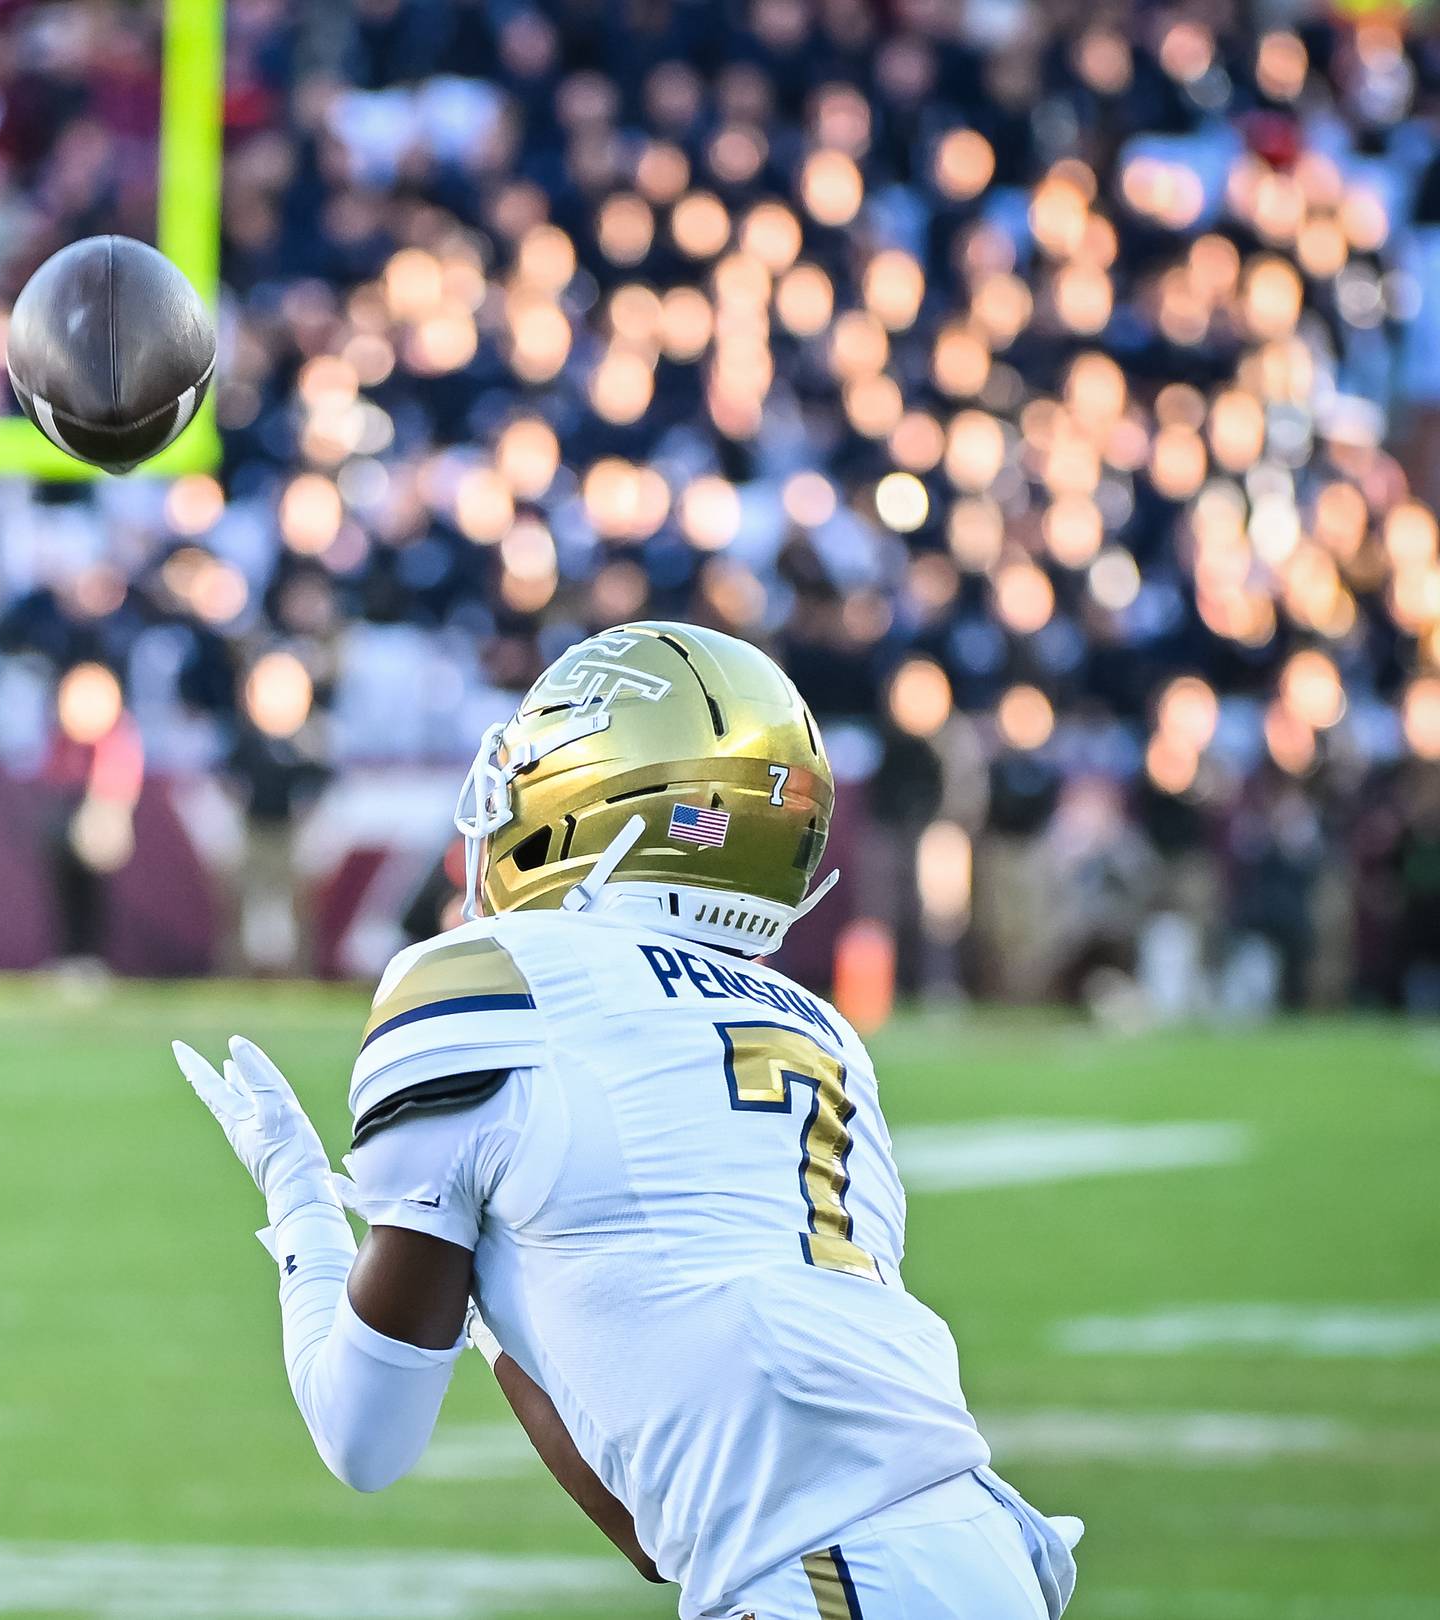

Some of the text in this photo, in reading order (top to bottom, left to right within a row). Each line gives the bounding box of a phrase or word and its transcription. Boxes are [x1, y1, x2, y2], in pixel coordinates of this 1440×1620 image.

[768, 764, 790, 807] 7
[695, 904, 779, 937] JACKETS
[637, 944, 844, 1048] PENSON
[713, 1020, 887, 1286] 7
